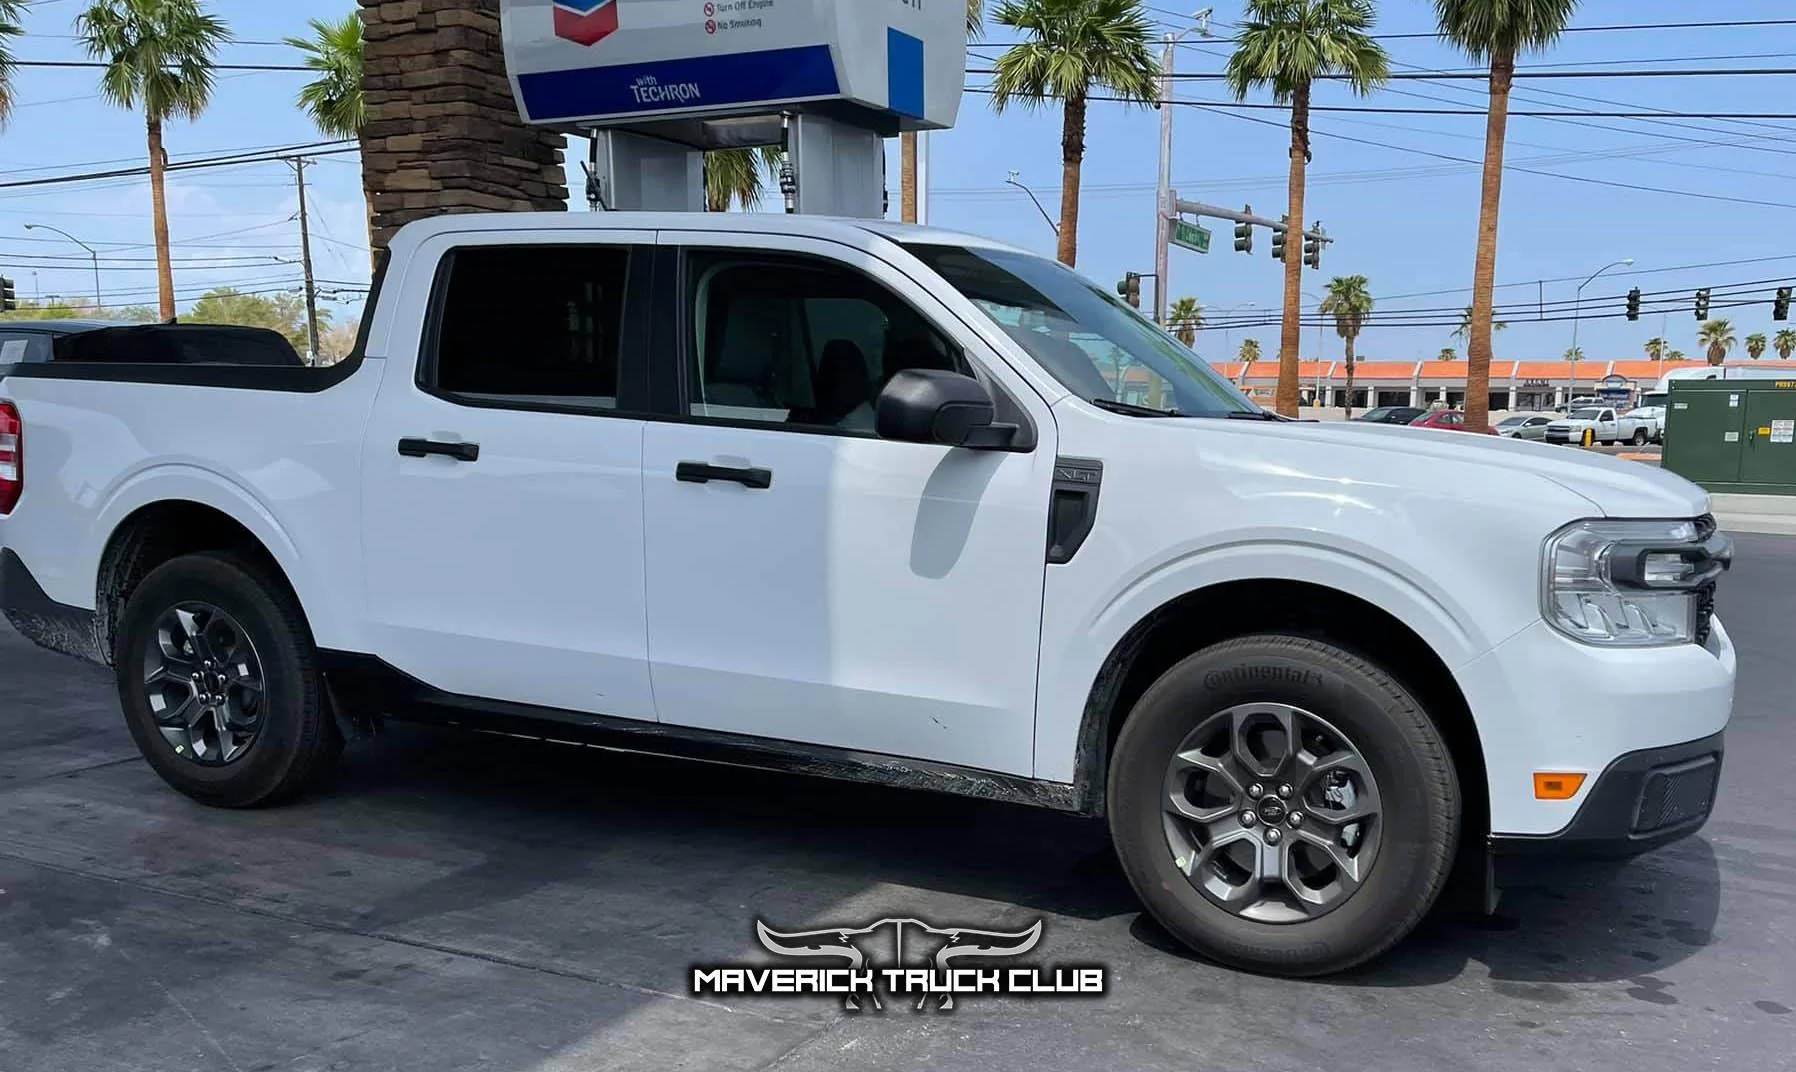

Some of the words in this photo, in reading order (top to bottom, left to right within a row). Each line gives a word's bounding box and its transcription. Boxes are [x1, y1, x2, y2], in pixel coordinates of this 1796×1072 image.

[717, 3, 733, 12] Turn
[734, 1, 746, 11] Off
[748, 0, 774, 9] Engine
[717, 22, 728, 30] No
[729, 18, 763, 29] Smoking
[635, 75, 658, 86] with
[630, 82, 701, 104] TECHRON
[1203, 664, 1311, 690] Continental
